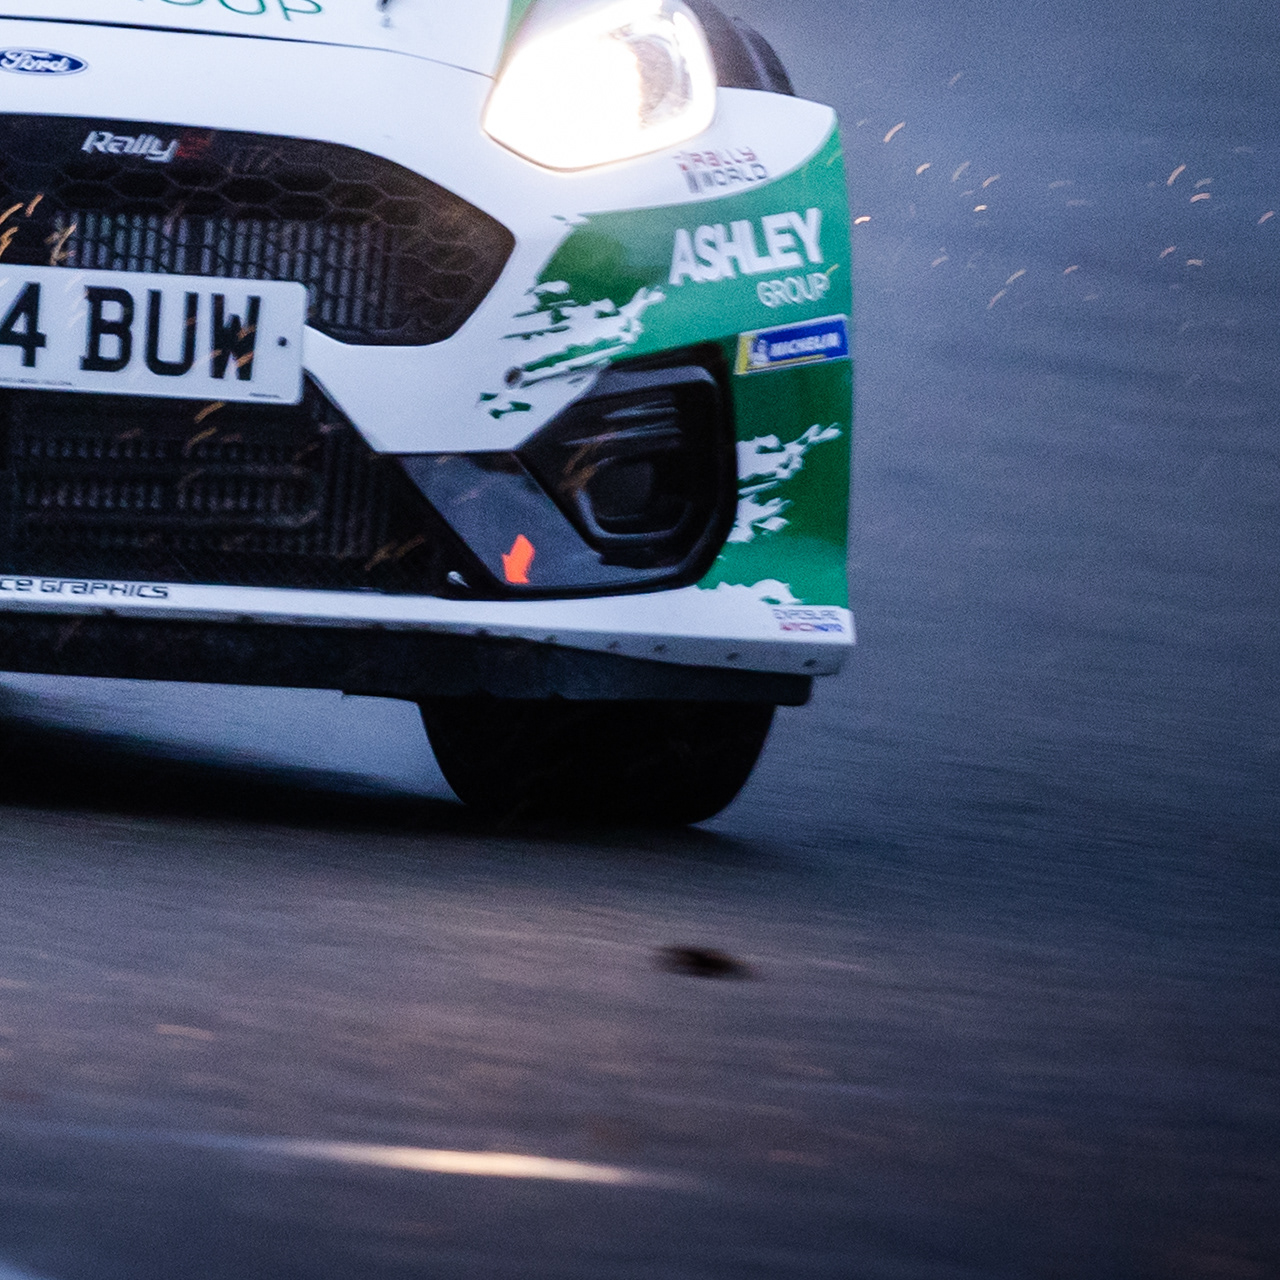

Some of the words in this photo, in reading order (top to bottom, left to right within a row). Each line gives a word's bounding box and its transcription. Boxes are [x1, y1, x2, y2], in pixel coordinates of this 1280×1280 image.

[0, 50, 71, 72] Ford
[668, 207, 824, 287] ASHLEY
[755, 272, 831, 309] GROUP
[80, 284, 262, 382] BUW
